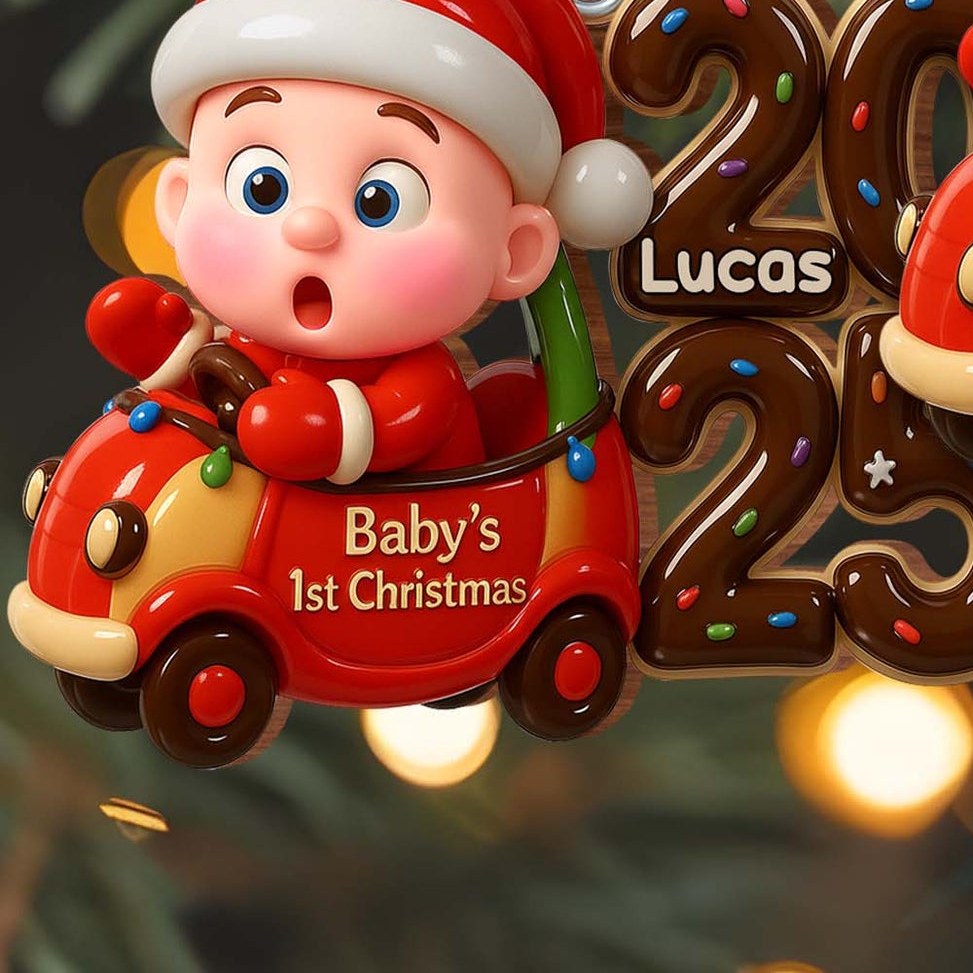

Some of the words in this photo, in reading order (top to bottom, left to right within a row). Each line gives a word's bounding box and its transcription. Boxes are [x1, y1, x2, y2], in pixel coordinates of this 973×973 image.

[640, 238, 832, 294] Lucas
[345, 502, 501, 563] Baby’s
[290, 568, 339, 611] 1st
[348, 569, 527, 611] Christmas
